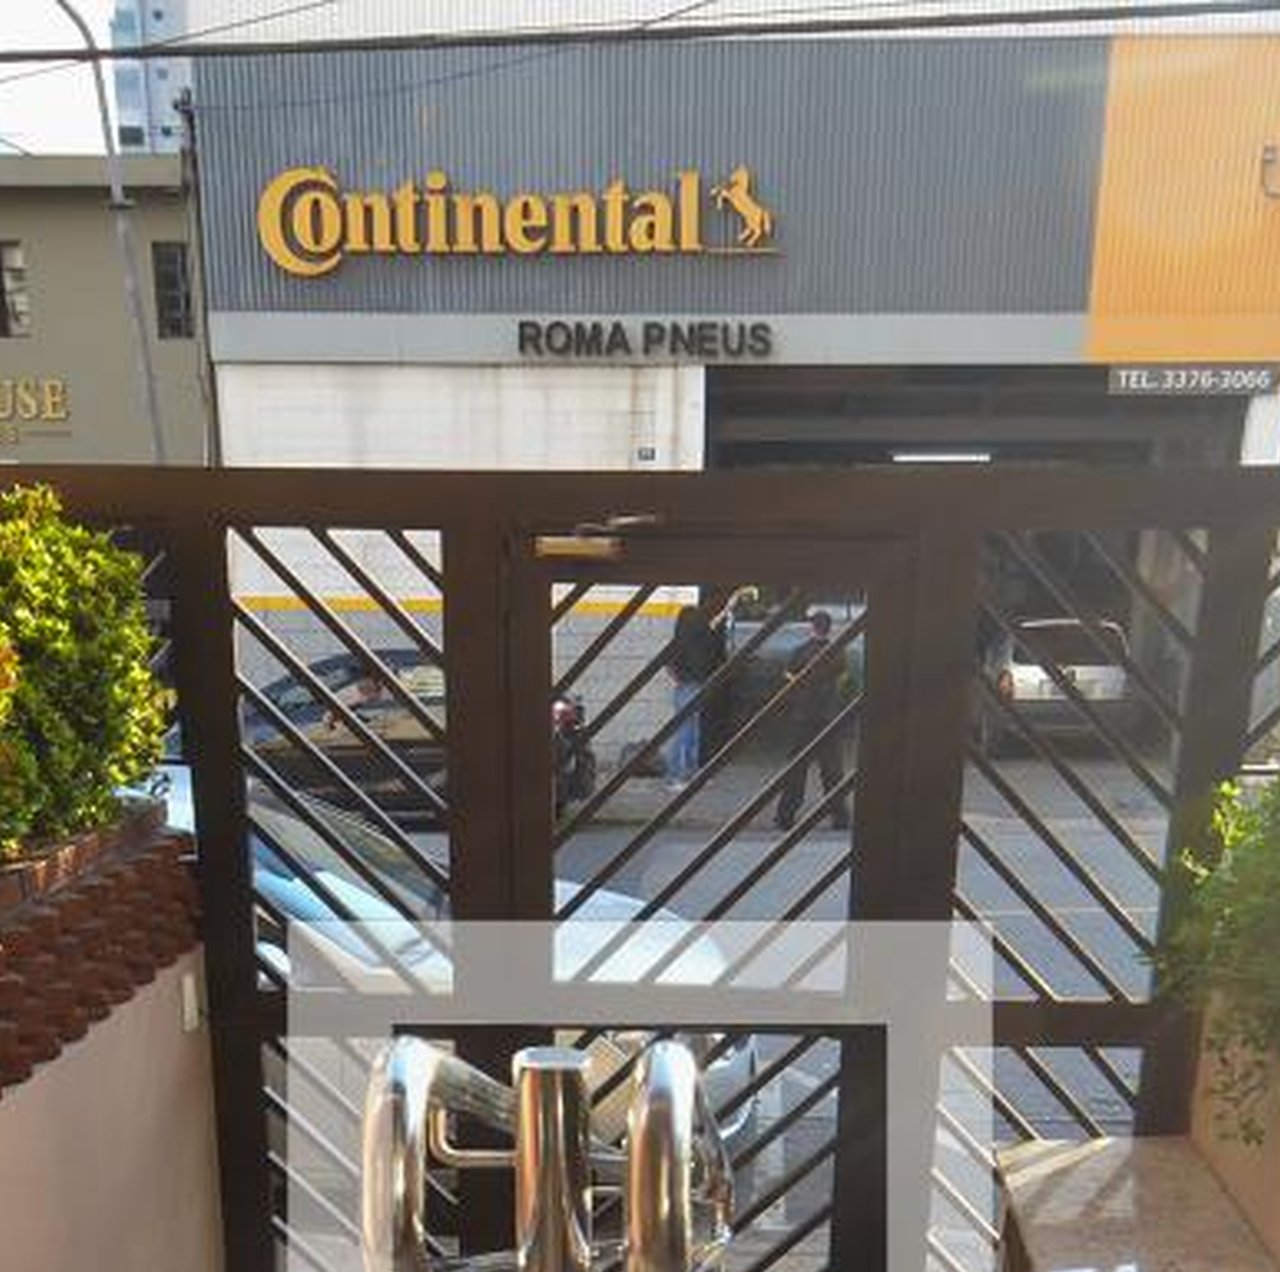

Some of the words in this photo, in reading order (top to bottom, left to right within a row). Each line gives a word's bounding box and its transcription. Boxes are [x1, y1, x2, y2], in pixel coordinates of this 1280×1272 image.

[257, 166, 702, 276] Continental
[518, 320, 631, 357] ROMA
[643, 322, 773, 358] PNEUS
